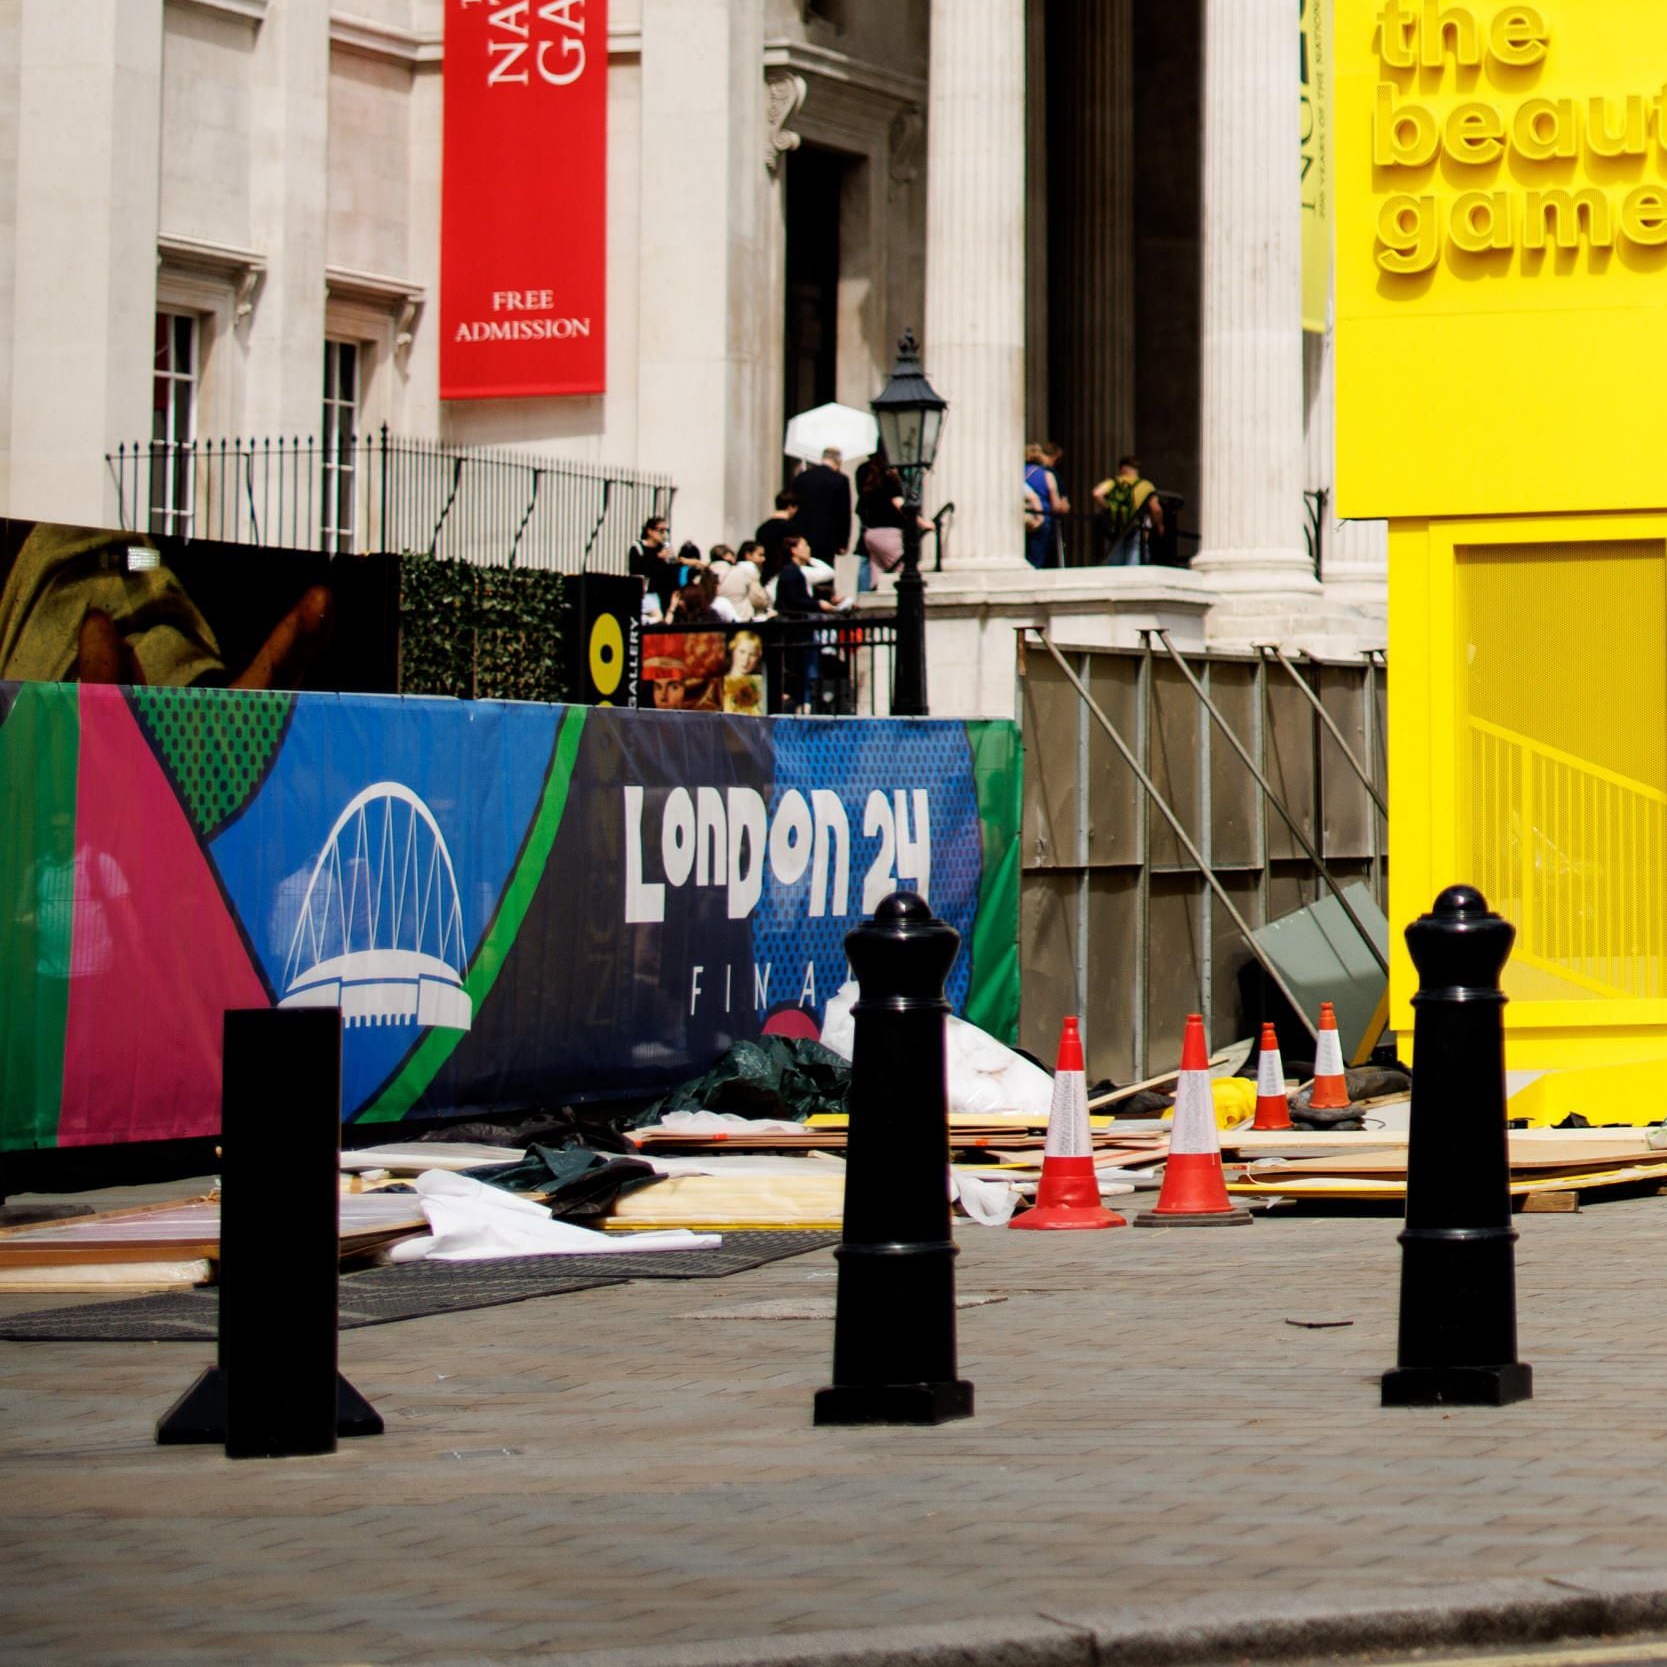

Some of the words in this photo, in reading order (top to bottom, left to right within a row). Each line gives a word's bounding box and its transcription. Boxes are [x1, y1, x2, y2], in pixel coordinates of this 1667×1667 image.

[1316, 71, 1324, 101] THE
[492, 289, 555, 312] FREE
[454, 317, 592, 343] ADMISSION
[861, 788, 932, 916] 24
[690, 960, 853, 1017] FINA
